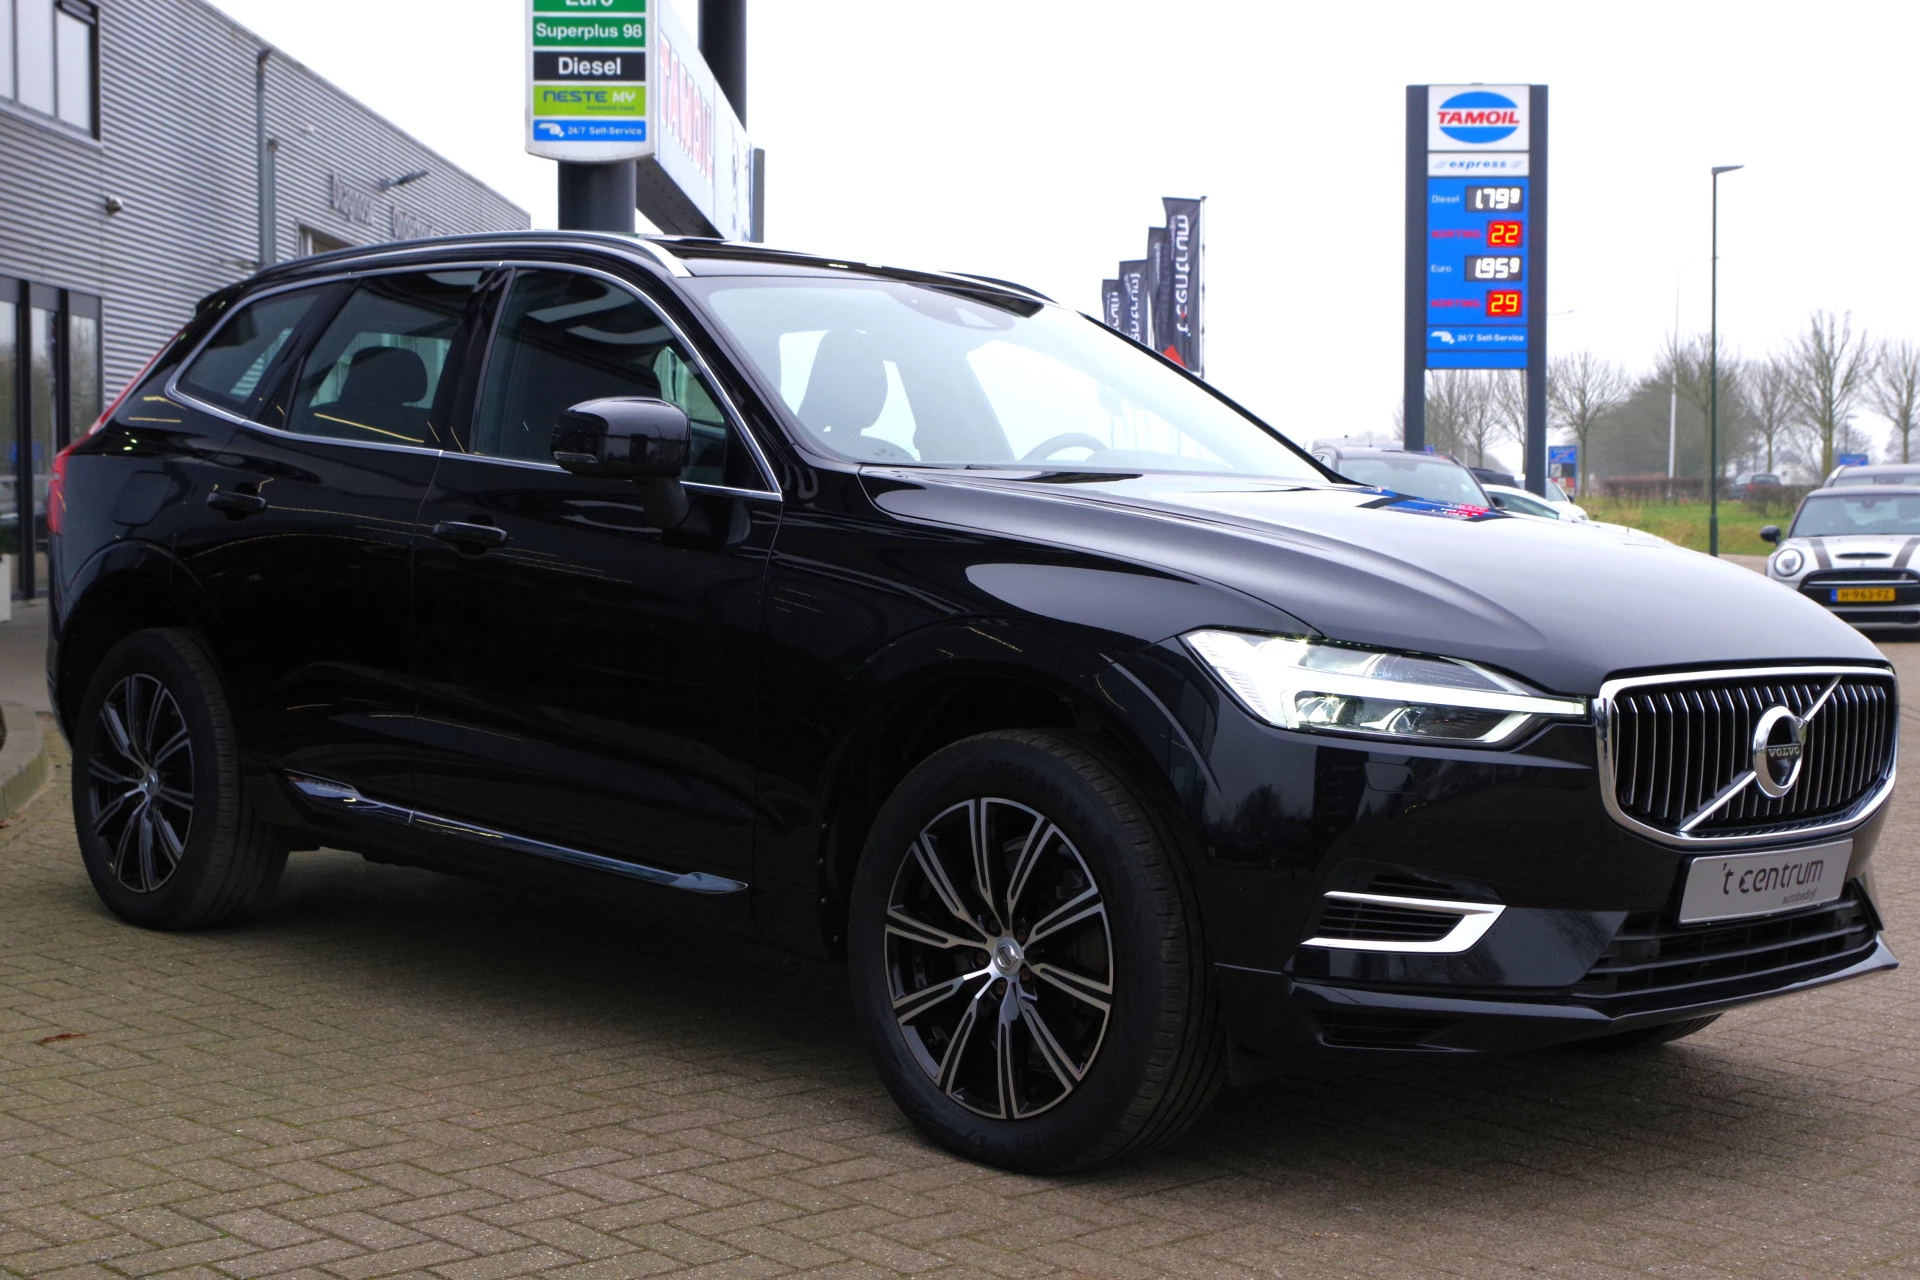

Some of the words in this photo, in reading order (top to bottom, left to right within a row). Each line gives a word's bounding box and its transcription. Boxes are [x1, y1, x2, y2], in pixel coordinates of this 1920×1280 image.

[535, 22, 619, 40] Superplus
[623, 23, 643, 39] 98
[558, 56, 622, 76] Diesel
[612, 90, 637, 104] MY
[1437, 111, 1520, 126] TAMOIL
[567, 126, 586, 136] 24/7
[588, 126, 643, 136] Self-Service
[1449, 159, 1507, 170] express
[1431, 194, 1460, 204] Diesel
[1490, 224, 1520, 244] 22
[1430, 263, 1453, 273] Euro
[1490, 293, 1519, 313] 29
[1457, 333, 1474, 343] 24/7
[1476, 333, 1525, 343] Self-Service
[1841, 589, 1891, 601] H-963-FZ
[1767, 746, 1801, 758] VOLVO
[1722, 862, 1734, 896] 't
[1738, 860, 1825, 895] centrum
[1781, 887, 1819, 905] autobedrijf
